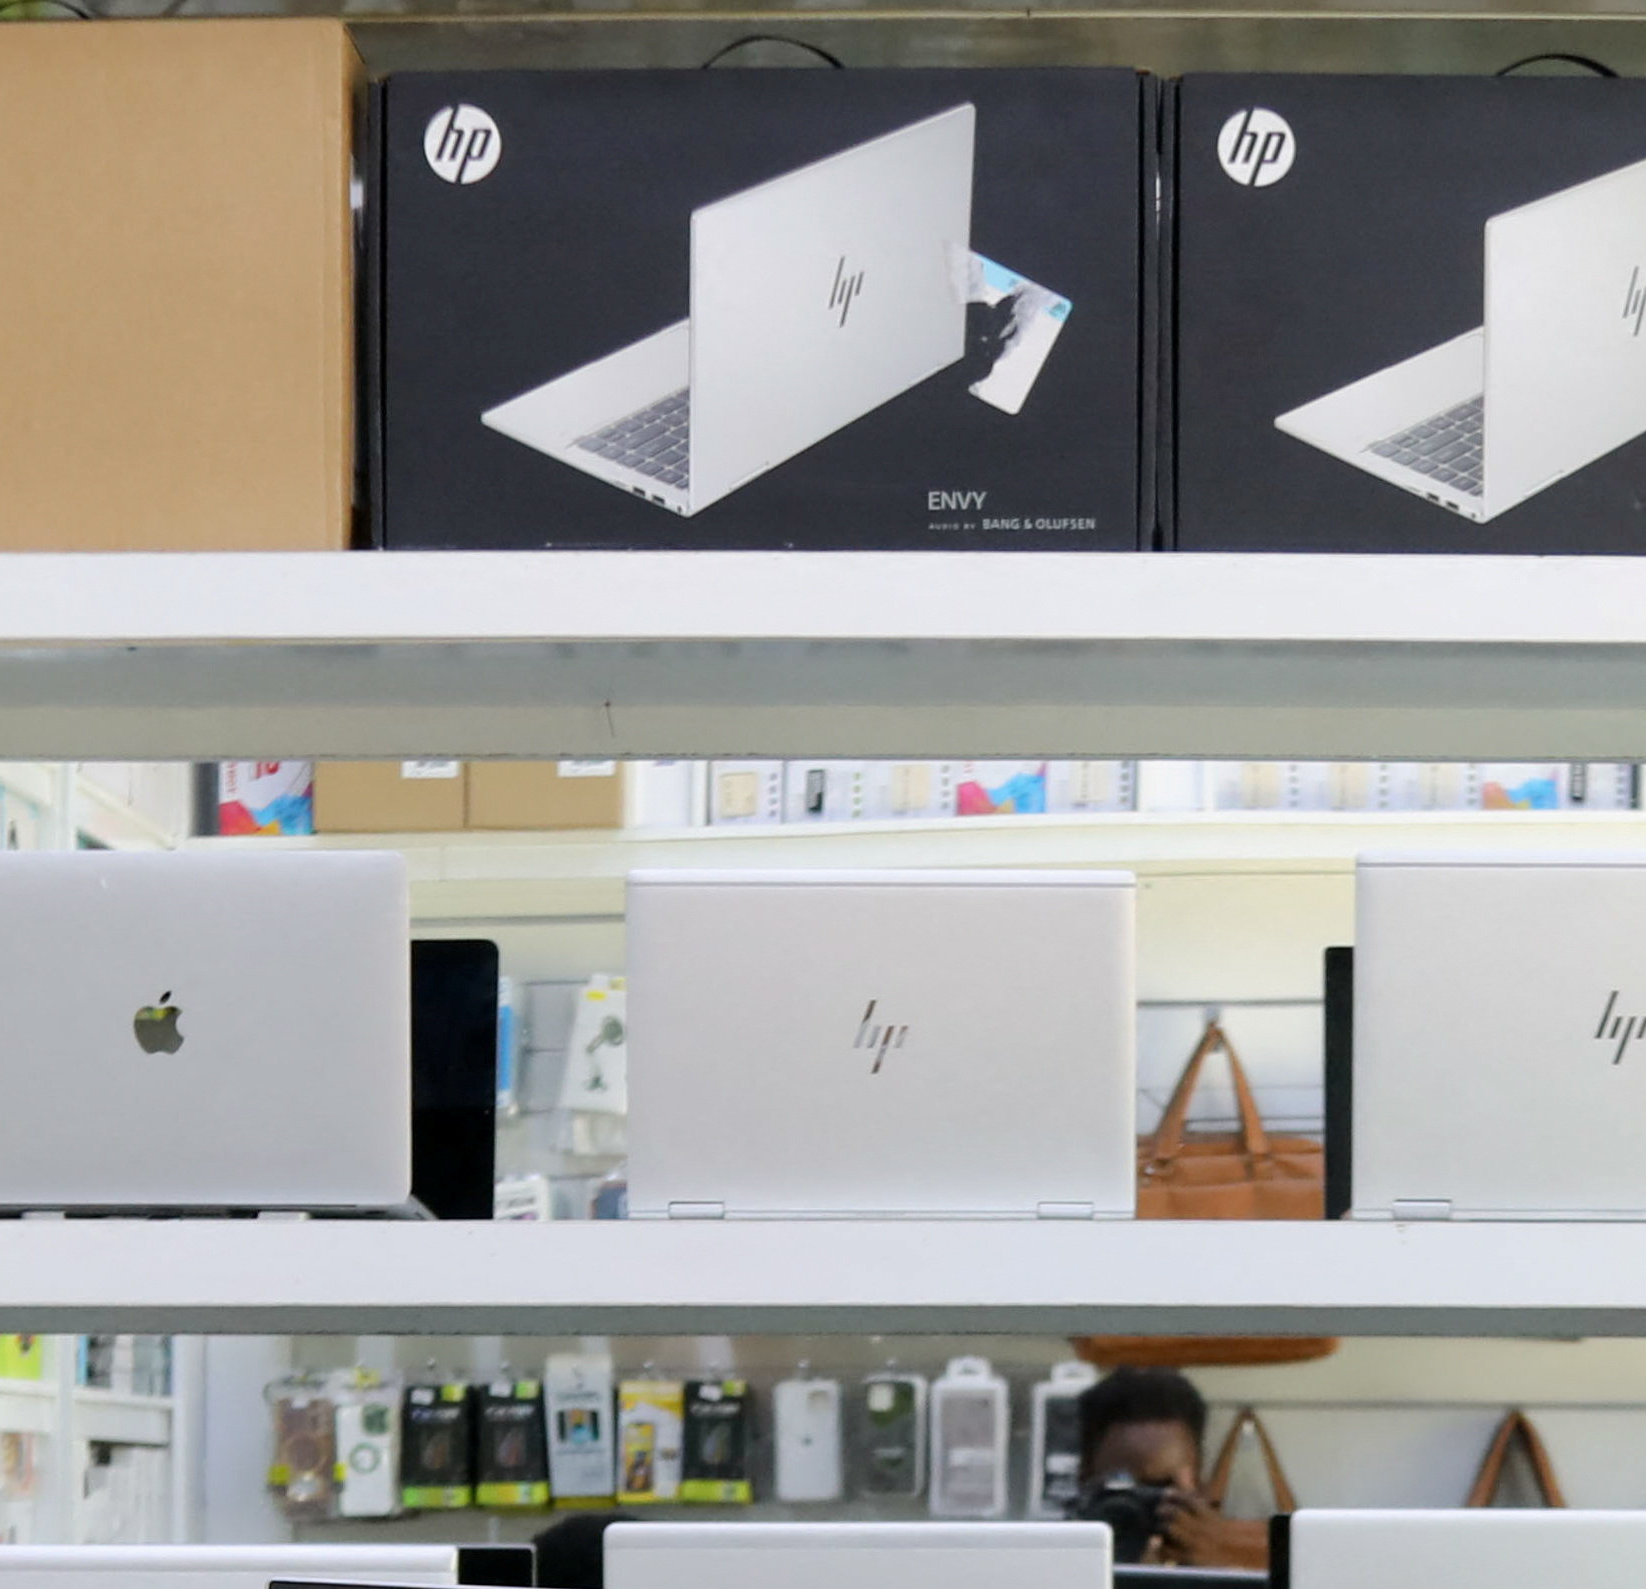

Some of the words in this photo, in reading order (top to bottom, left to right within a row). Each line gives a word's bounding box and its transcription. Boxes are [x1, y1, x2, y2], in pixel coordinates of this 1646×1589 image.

[432, 103, 493, 184] hp
[1227, 108, 1287, 187] hp
[928, 491, 987, 511] ENVY
[982, 518, 1020, 530] BANG
[1023, 518, 1033, 530] &
[1035, 518, 1096, 531] OLUFSEN
